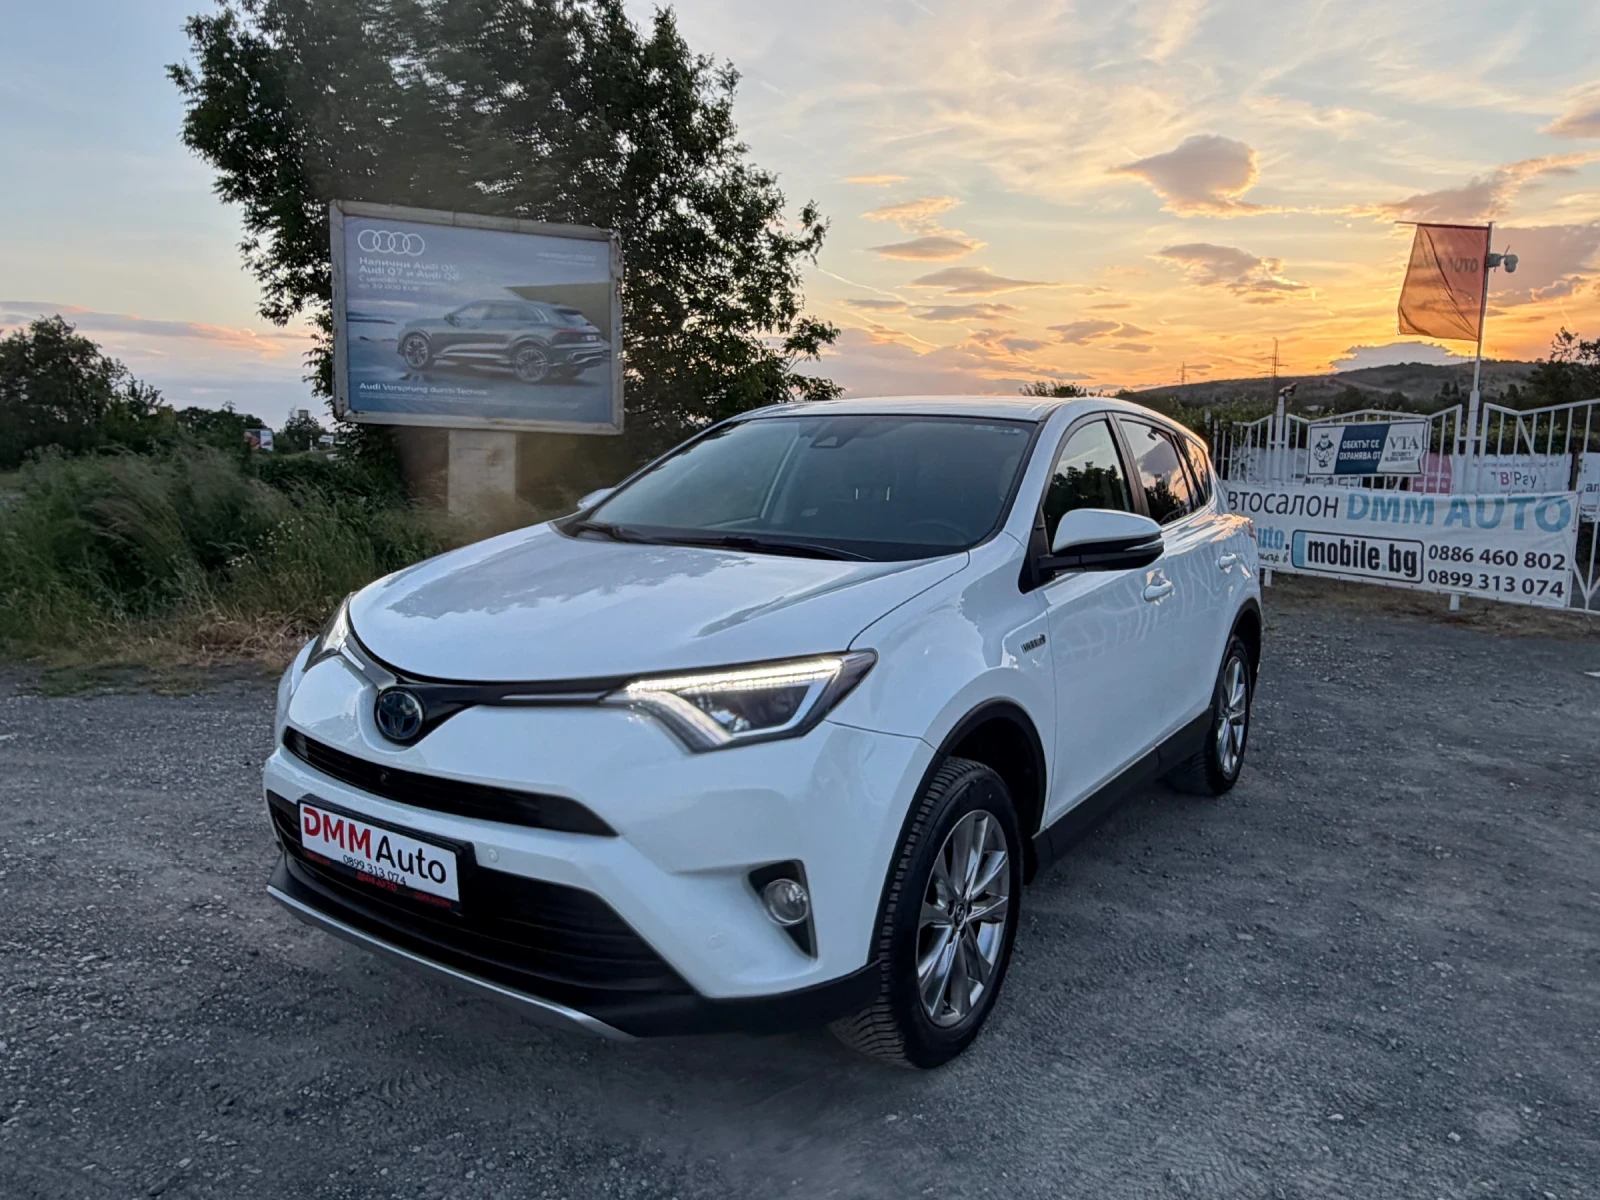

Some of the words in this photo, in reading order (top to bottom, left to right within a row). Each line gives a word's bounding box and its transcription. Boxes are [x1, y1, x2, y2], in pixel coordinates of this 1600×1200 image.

[360, 265, 385, 275] Audi
[416, 270, 442, 280] Audi
[359, 382, 381, 391] Audi
[1342, 440, 1369, 449] ОБЕКТЪТ
[1370, 439, 1380, 448] СЕ
[1389, 436, 1419, 450] VTA
[1339, 451, 1371, 460] ОХРАНЯВА
[1372, 451, 1382, 460] ОТ
[1513, 471, 1537, 489] Pay
[1227, 490, 1339, 519] втосалон
[1346, 493, 1435, 526] DMM
[1443, 495, 1572, 533] AUTO
[1307, 538, 1417, 578] mobile.bg
[1428, 544, 1474, 563] 0886
[1479, 548, 1518, 567] 460
[1523, 551, 1566, 571] 802
[1428, 569, 1473, 588] 0899
[1478, 573, 1516, 593] 313
[1521, 578, 1564, 598] 074
[343, 854, 365, 870] 0899
[367, 864, 386, 879] 313
[387, 870, 407, 886] 074
